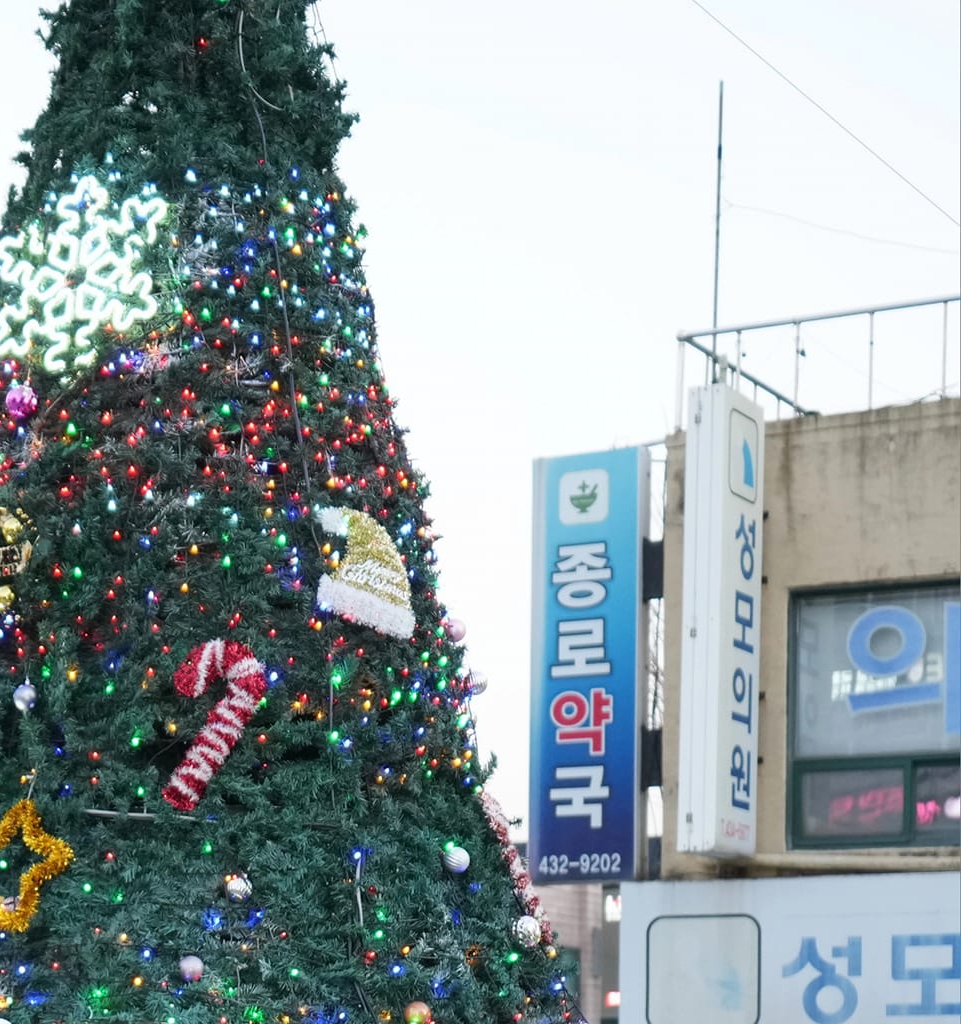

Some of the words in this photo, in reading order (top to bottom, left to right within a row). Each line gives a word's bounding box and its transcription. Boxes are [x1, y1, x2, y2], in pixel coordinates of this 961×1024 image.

[550, 541, 614, 830] 종로약국
[730, 514, 757, 812] 성모의원
[538, 852, 622, 876] 432-9202
